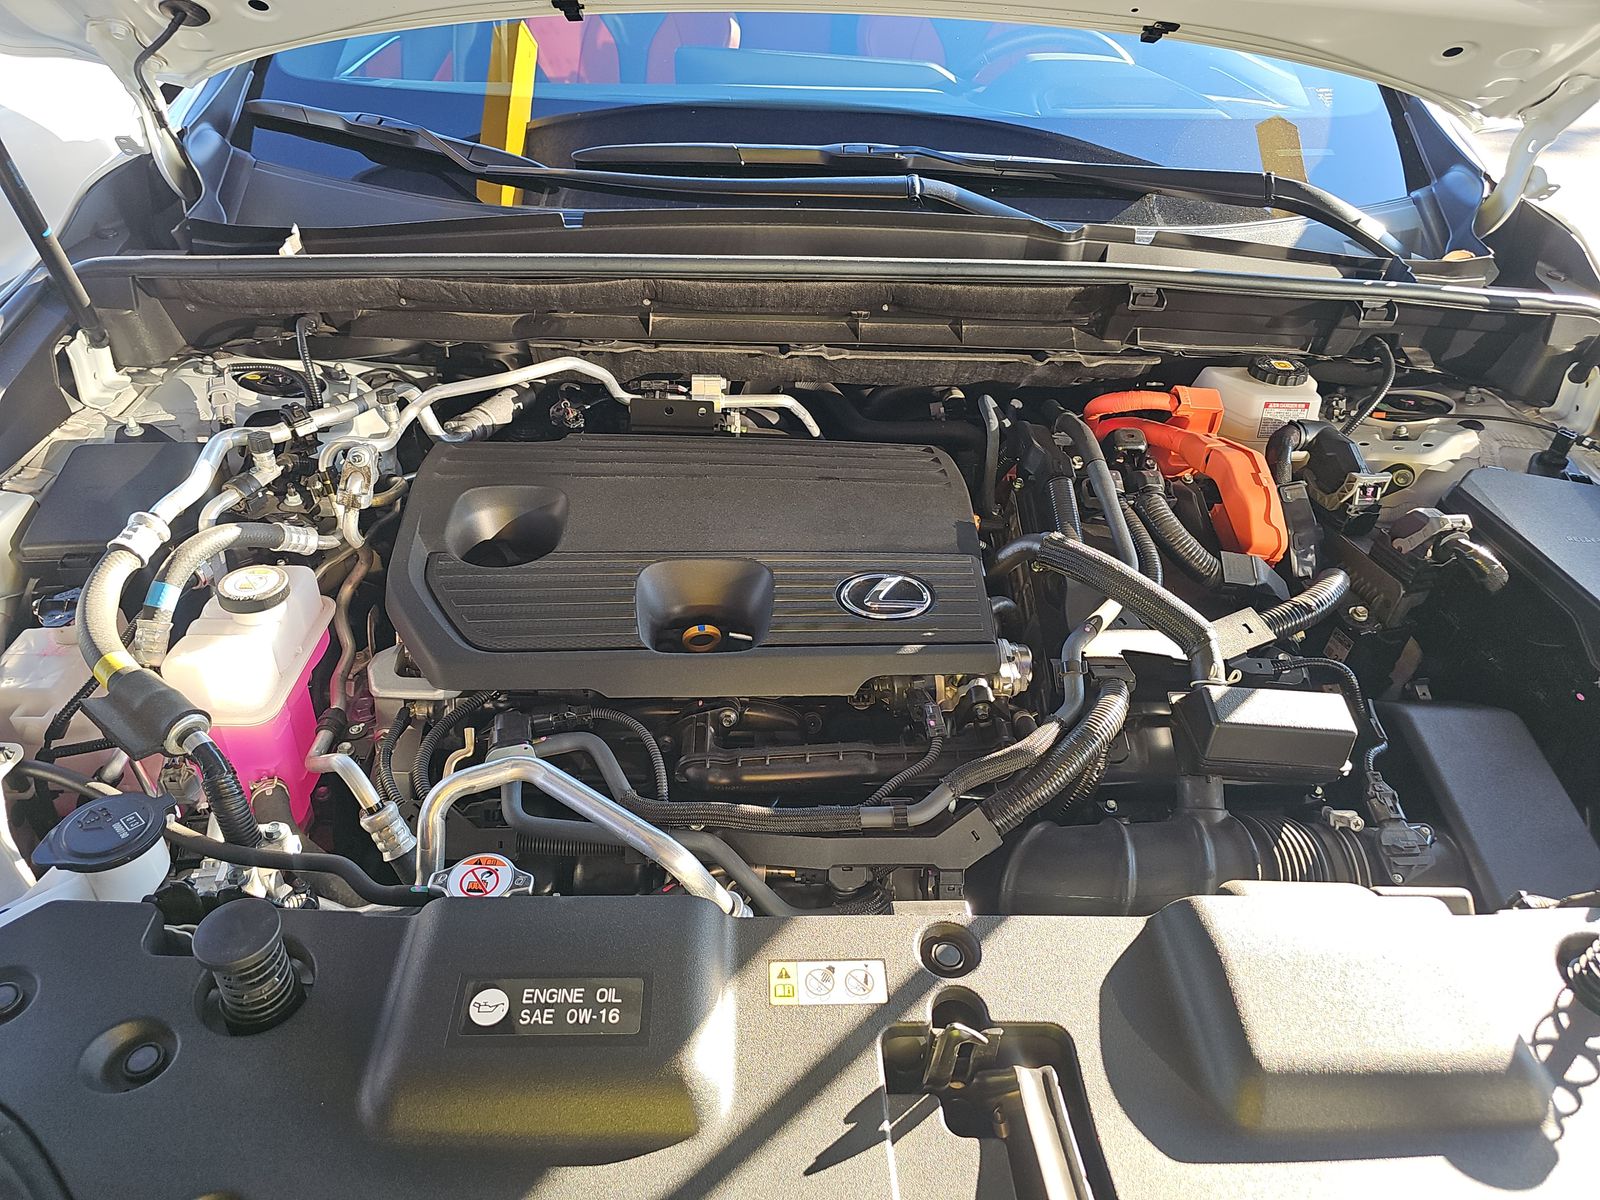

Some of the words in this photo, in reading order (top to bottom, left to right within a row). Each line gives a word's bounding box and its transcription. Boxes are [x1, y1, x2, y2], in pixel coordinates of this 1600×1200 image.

[522, 988, 584, 1003] ENGINE
[596, 988, 622, 1003] OIL
[519, 1009, 555, 1024] SAE
[566, 1008, 620, 1024] 0W-16
